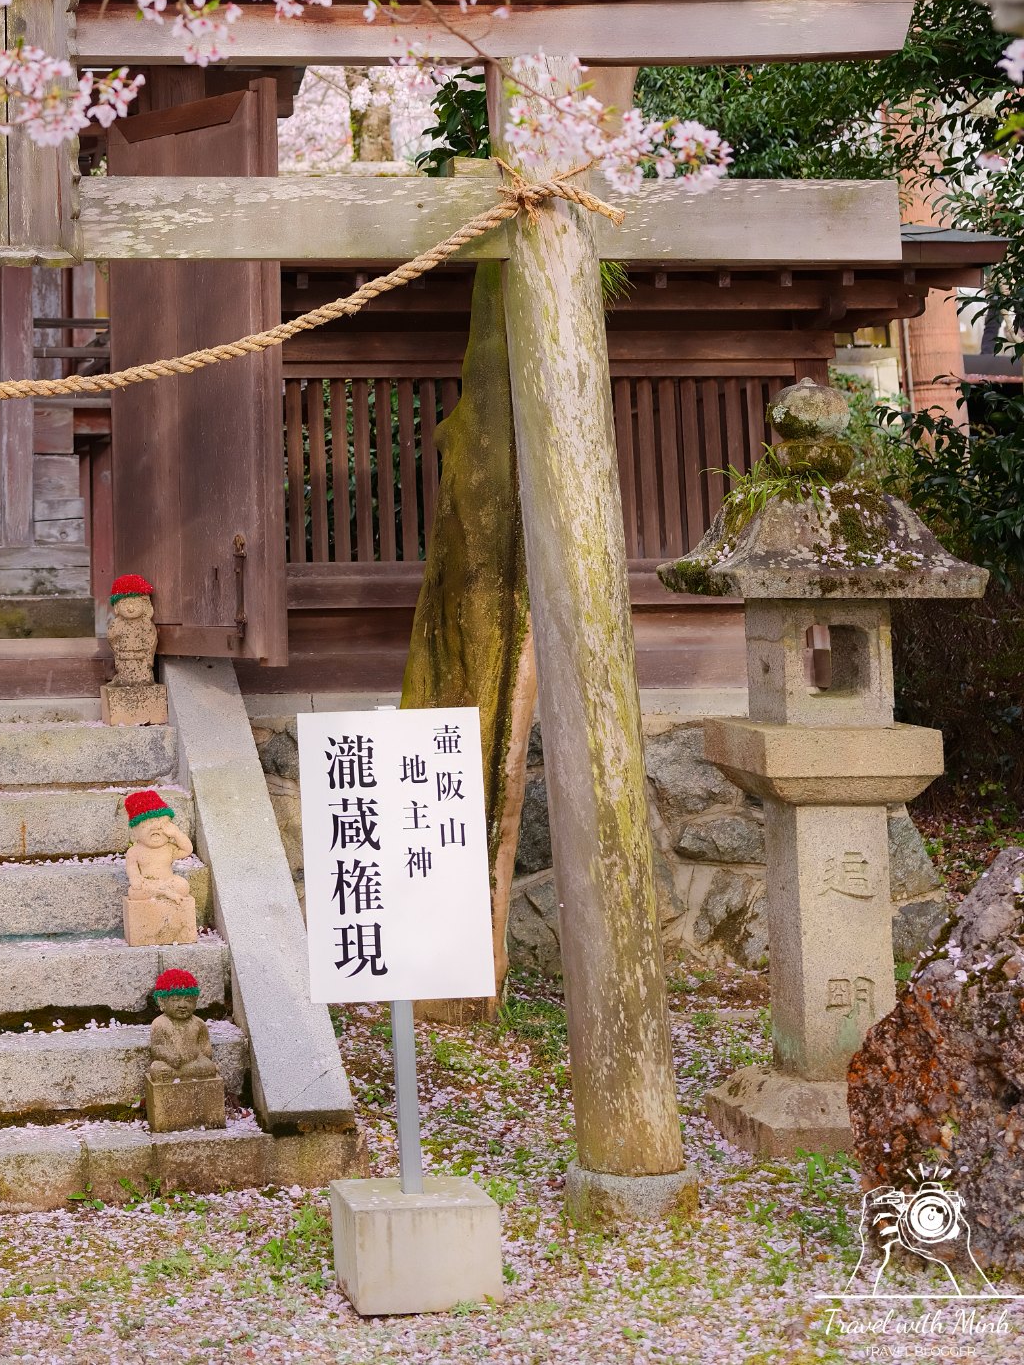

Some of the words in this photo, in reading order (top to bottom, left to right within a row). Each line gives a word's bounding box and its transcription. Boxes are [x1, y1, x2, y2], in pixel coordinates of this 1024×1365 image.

[325, 734, 389, 979] 瀧蔵権現
[399, 754, 433, 879] 地主神
